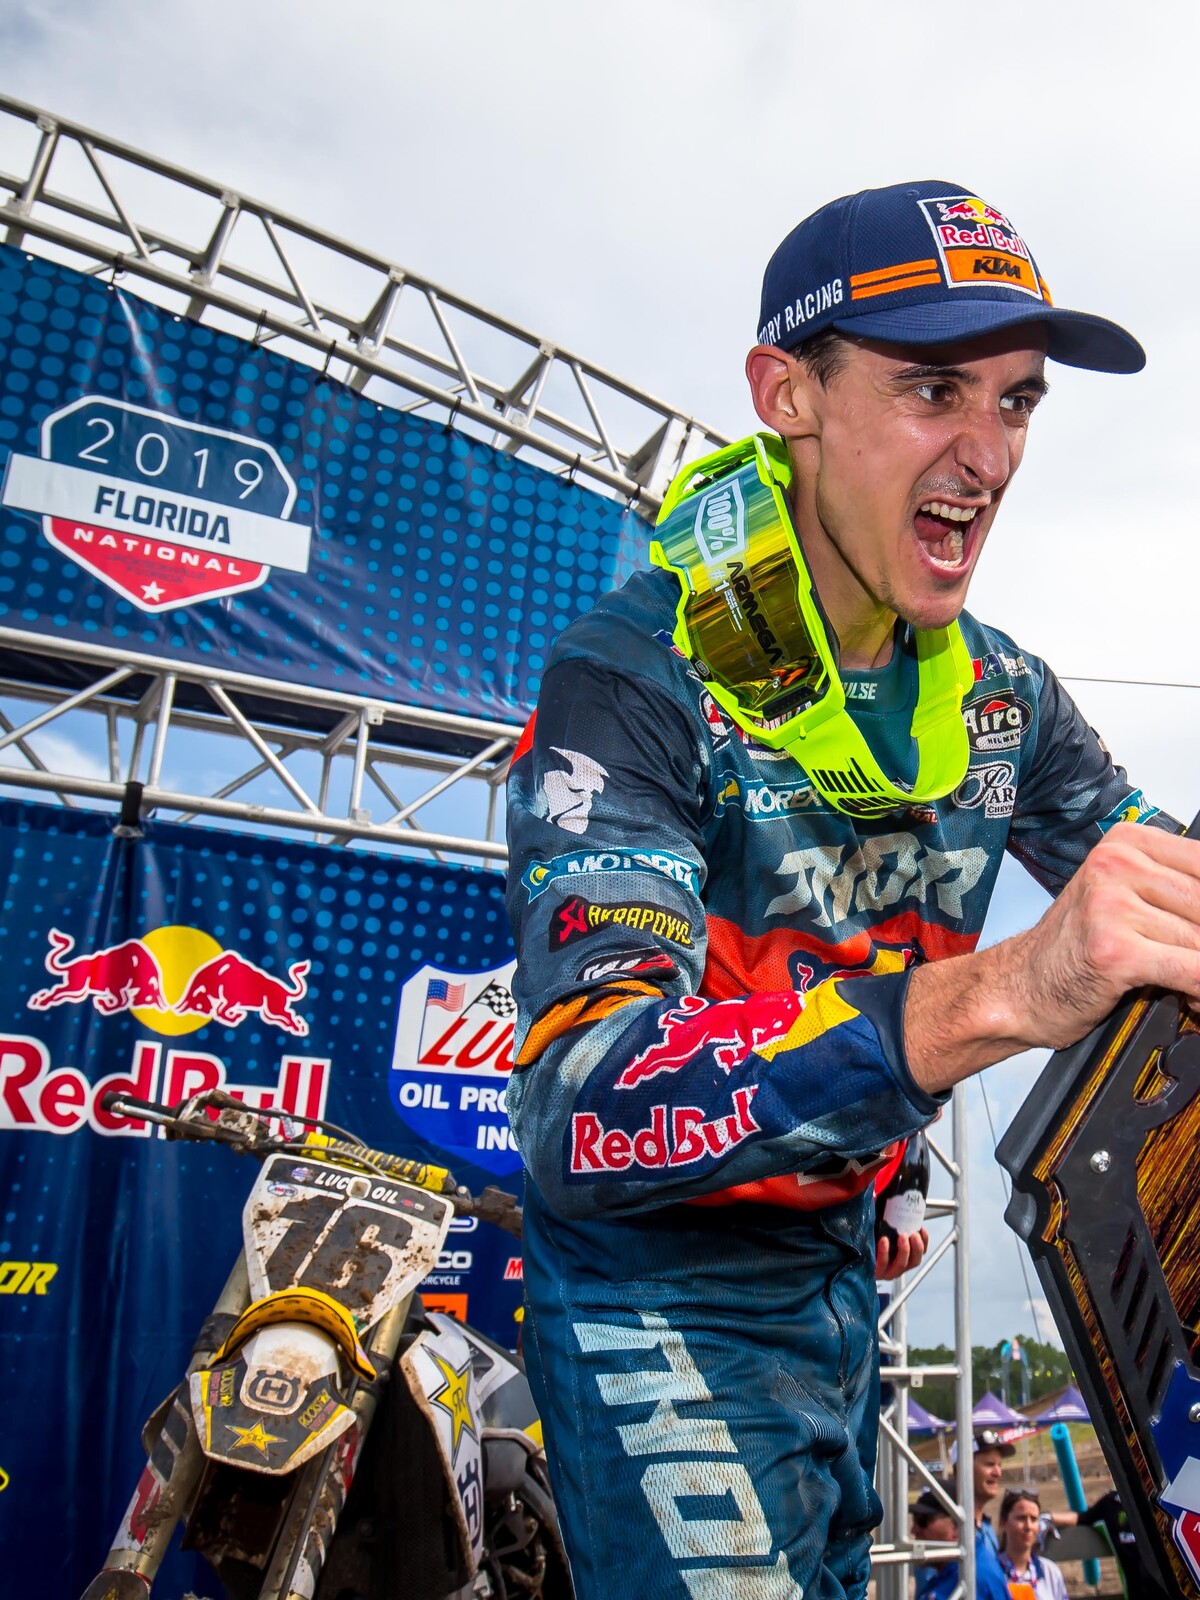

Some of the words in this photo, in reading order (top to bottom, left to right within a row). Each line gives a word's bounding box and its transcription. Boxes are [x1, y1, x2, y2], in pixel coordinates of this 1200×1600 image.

[937, 224, 992, 248] Red
[973, 256, 1022, 280] KTM
[784, 278, 843, 332] RACING
[78, 418, 264, 500] 2019
[94, 485, 231, 545] FLORIDA
[706, 490, 738, 552] 100%
[74, 528, 242, 576] NATIONAL
[0, 1038, 158, 1132] Red
[399, 1082, 449, 1110] OIL
[571, 1103, 667, 1174] Red
[314, 1171, 349, 1191] LUC
[371, 1186, 400, 1205] OIL
